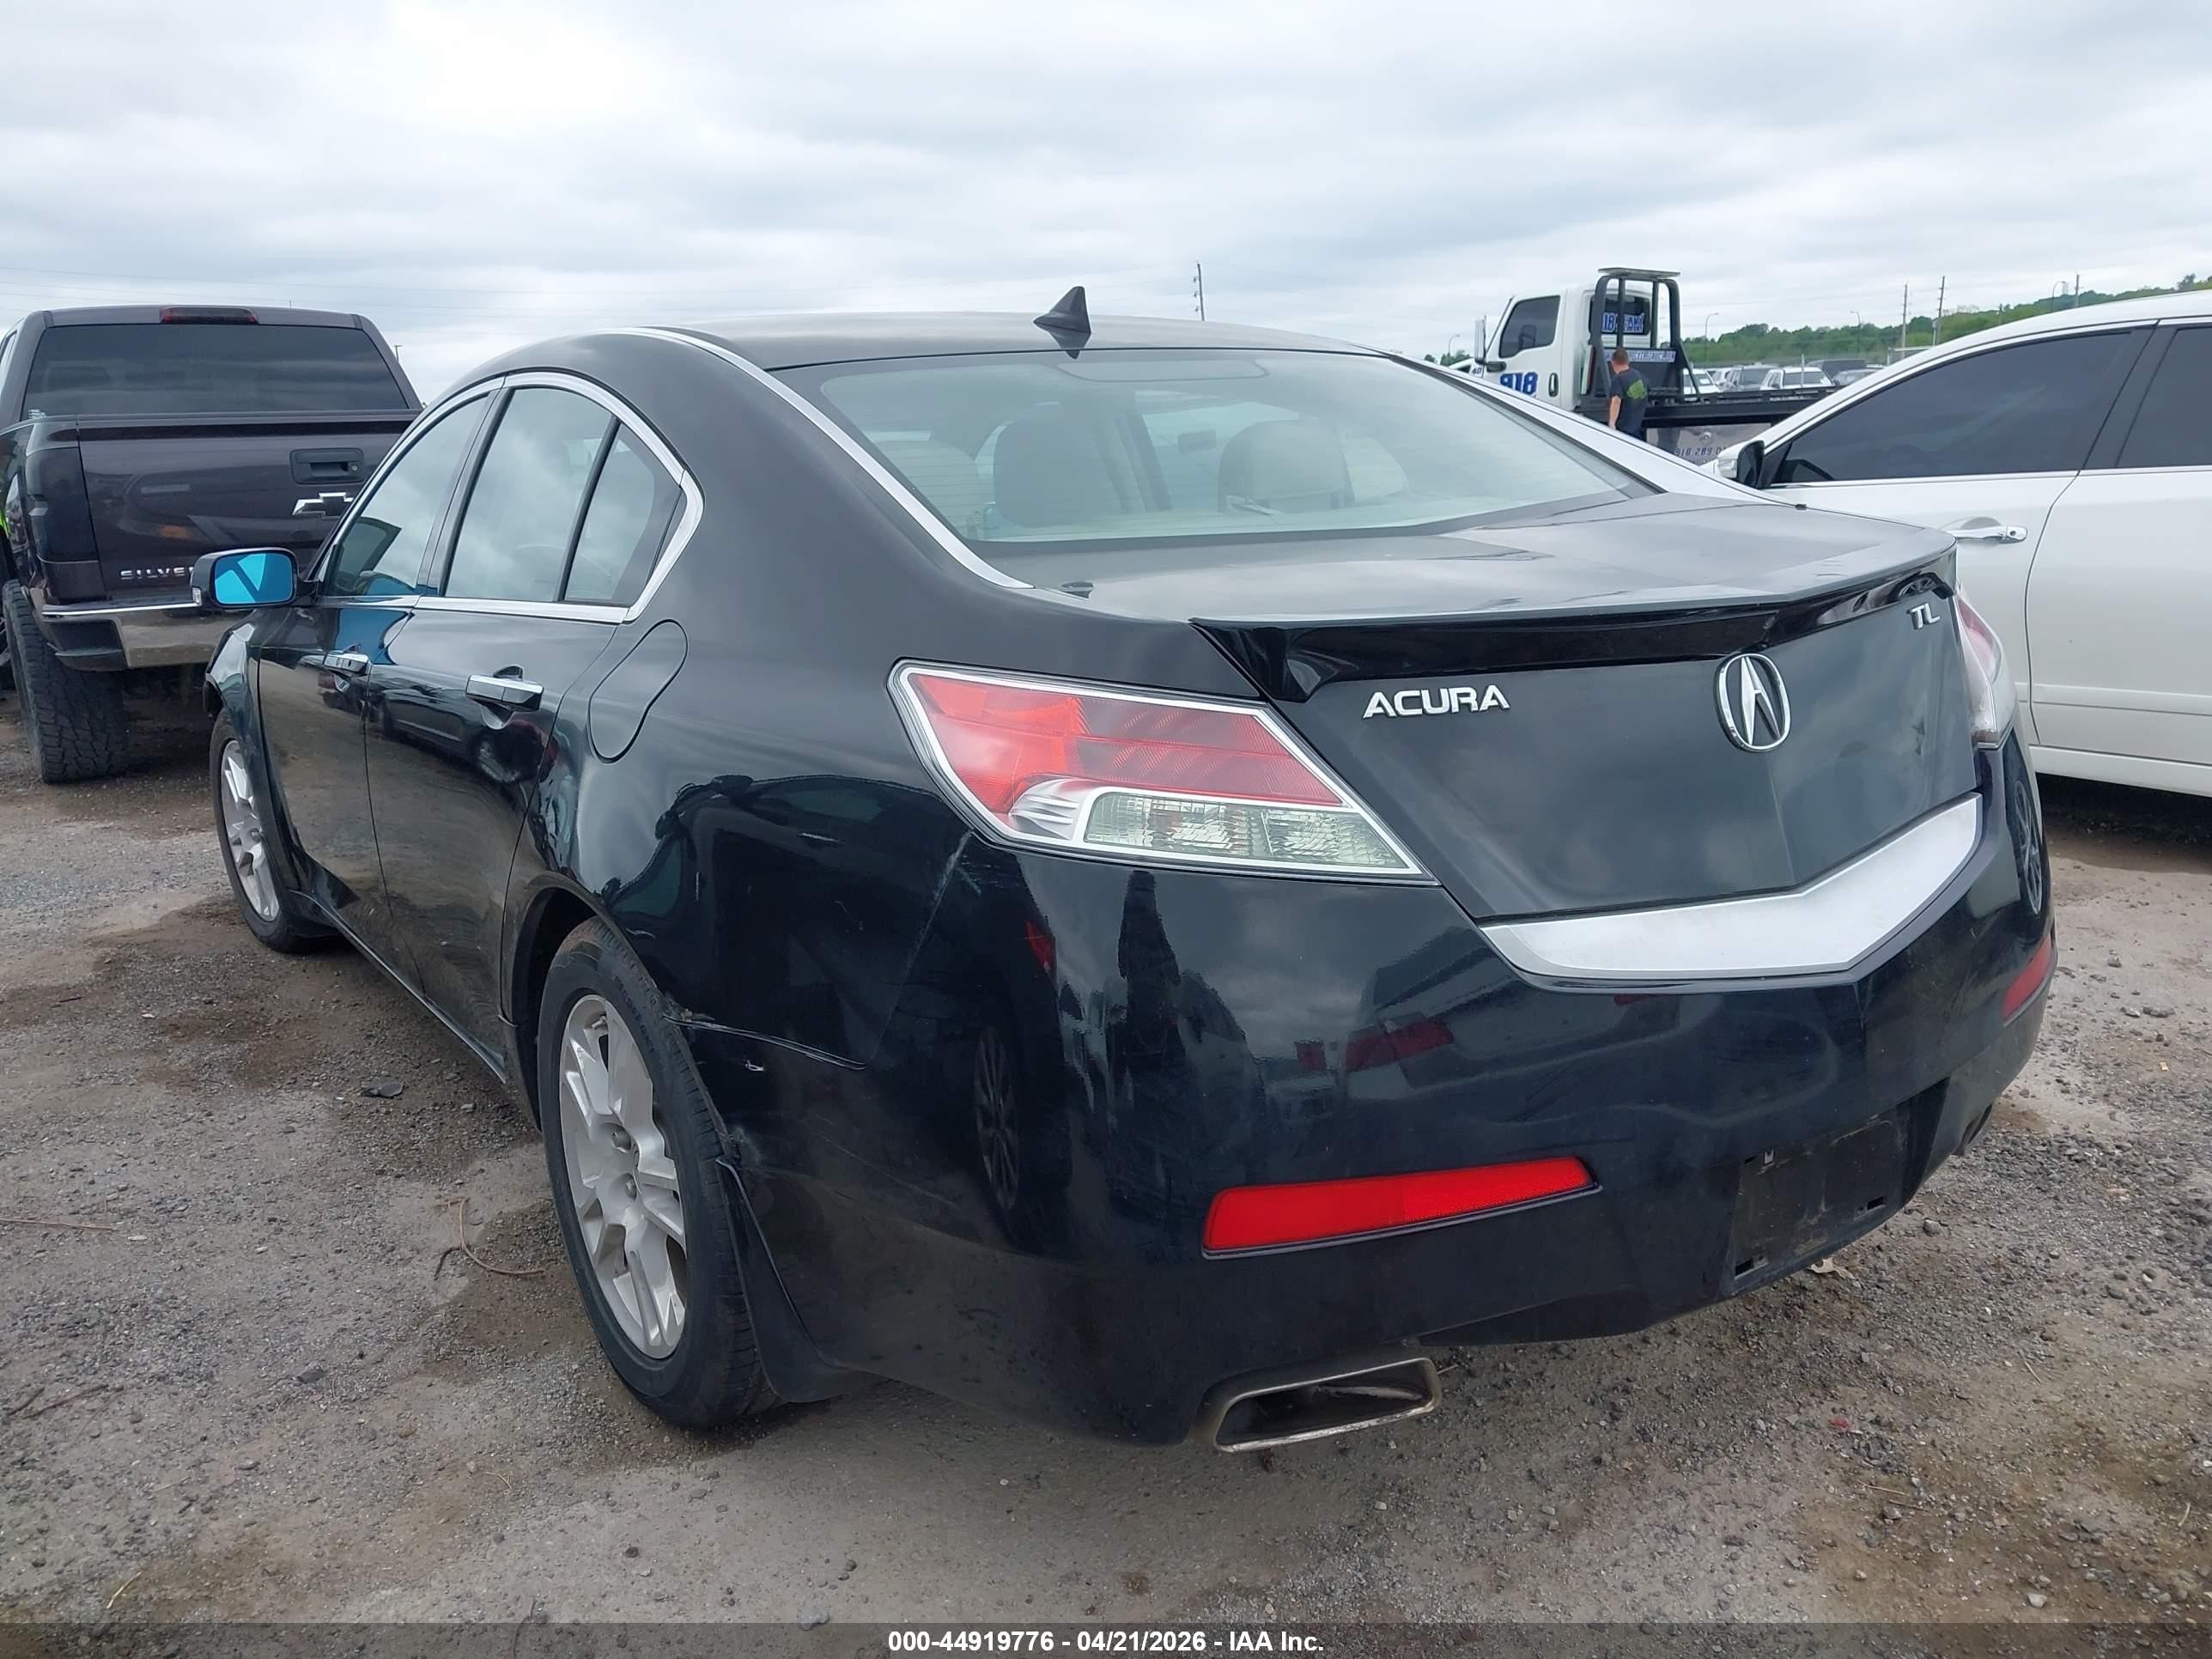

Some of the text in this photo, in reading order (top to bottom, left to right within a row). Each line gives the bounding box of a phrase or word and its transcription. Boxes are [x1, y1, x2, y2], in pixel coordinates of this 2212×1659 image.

[1500, 371, 1538, 395] 918
[1908, 603, 1941, 629] TL
[1363, 684, 1510, 720] ACURA
